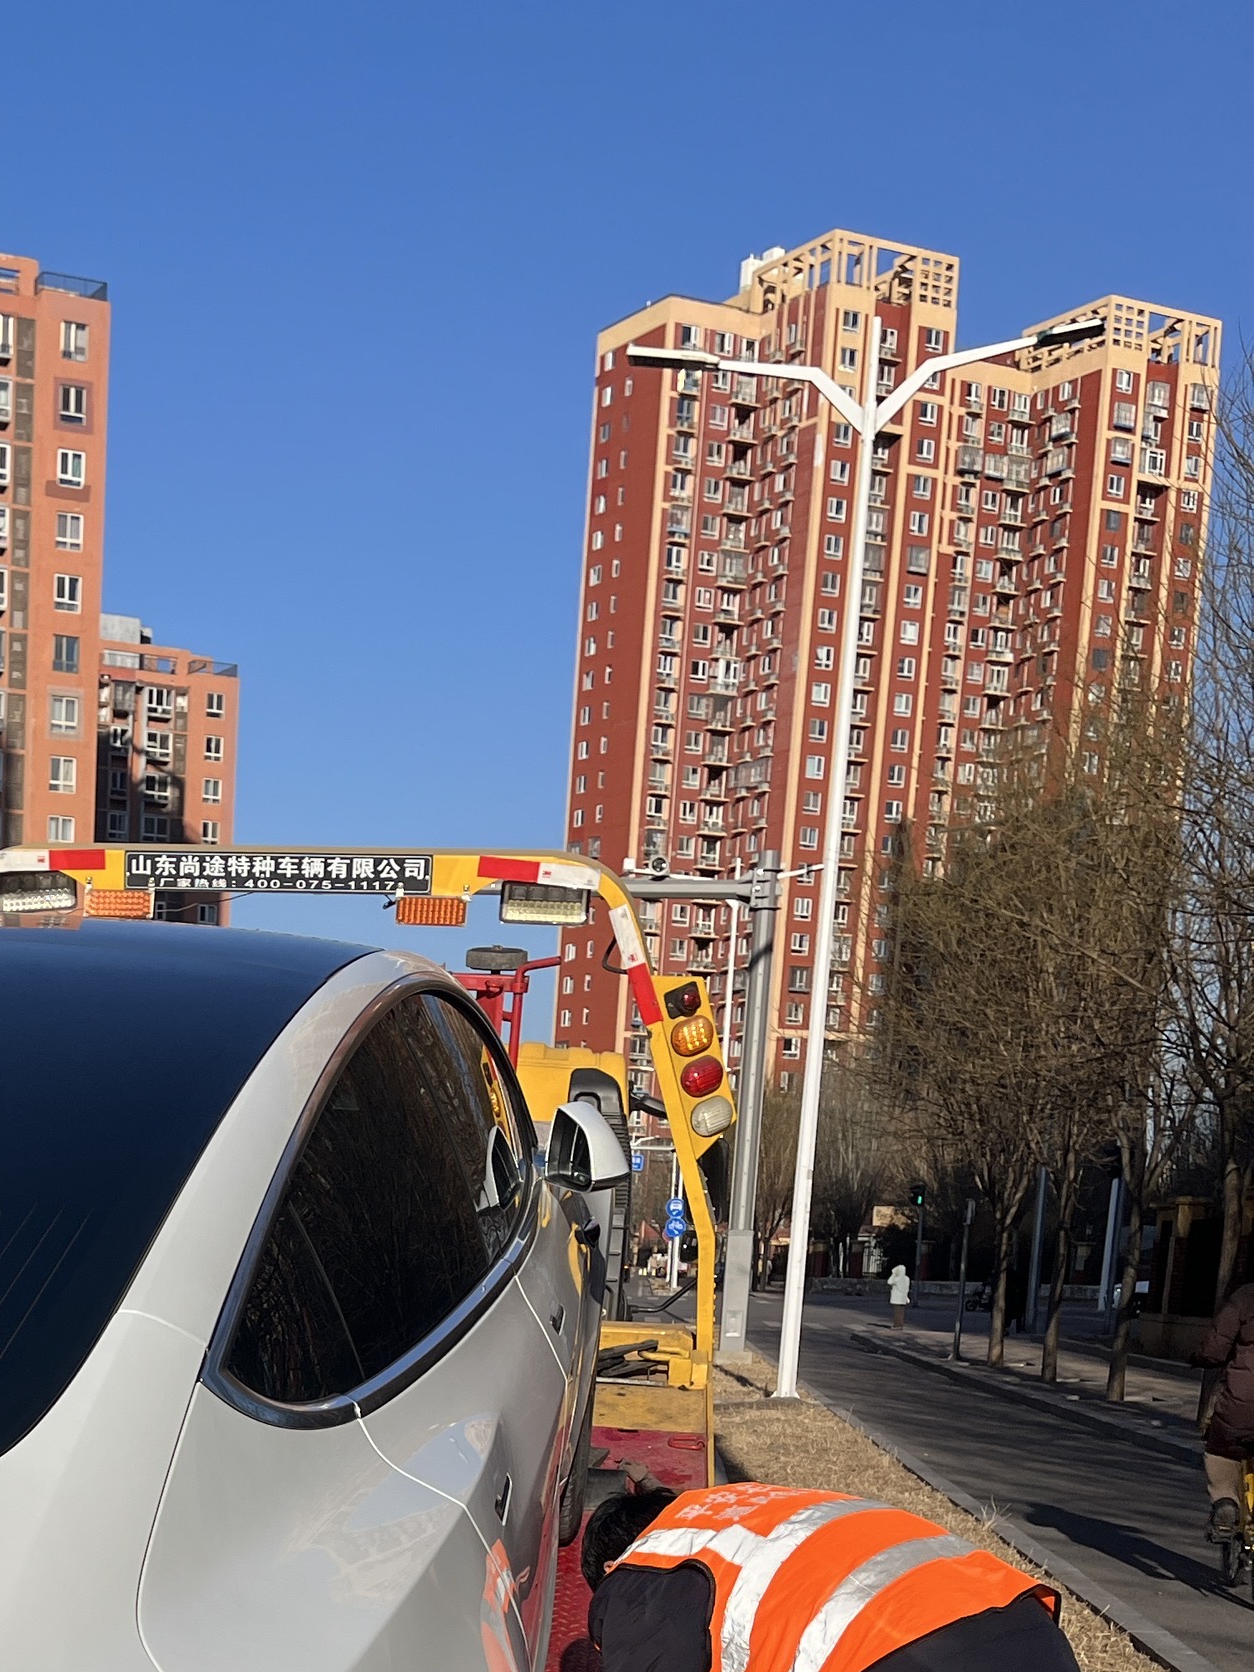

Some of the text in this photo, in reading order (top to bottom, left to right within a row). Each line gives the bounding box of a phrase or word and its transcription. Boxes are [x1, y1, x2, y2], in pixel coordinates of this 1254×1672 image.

[131, 855, 427, 879] 山东尚途特种车辆有限公司
